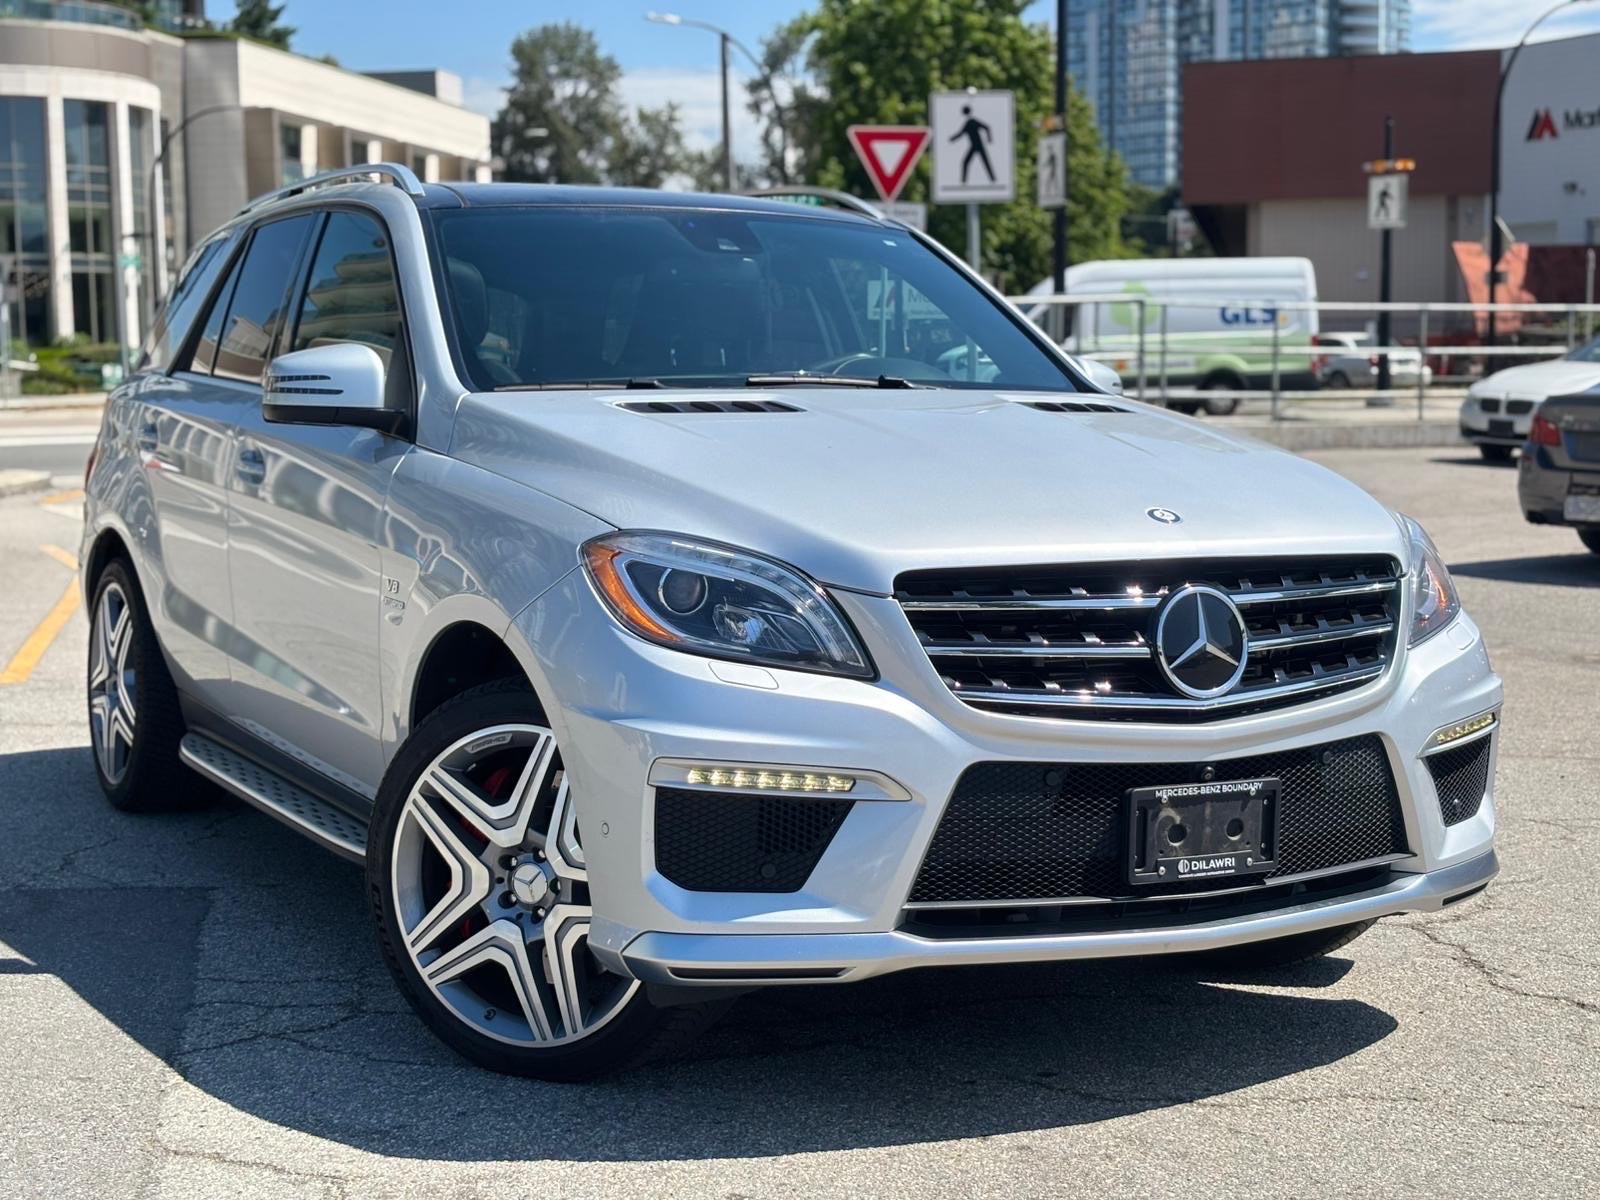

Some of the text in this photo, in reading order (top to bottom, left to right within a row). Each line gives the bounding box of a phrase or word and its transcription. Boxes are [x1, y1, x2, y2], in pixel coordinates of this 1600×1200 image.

[1155, 782, 1263, 798] MERCEDES-BENZ BOUNDARY
[1191, 857, 1235, 870] DILAWRI
